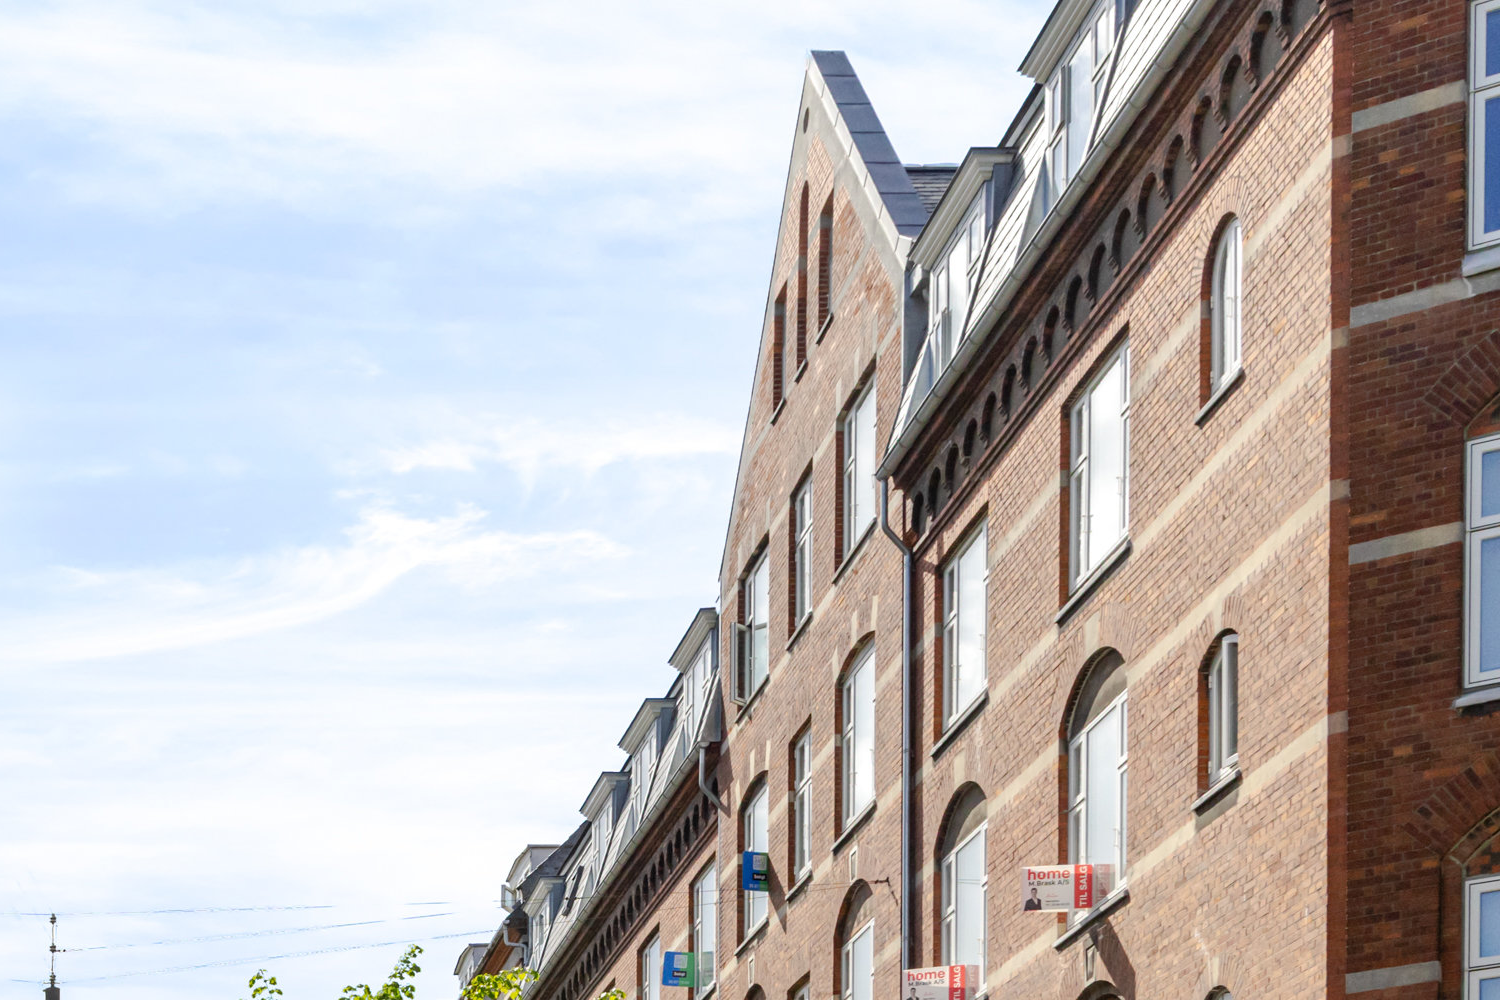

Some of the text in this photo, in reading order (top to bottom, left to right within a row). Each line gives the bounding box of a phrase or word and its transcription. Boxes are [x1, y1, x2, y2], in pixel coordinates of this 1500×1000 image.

[1028, 869, 1070, 880] home
[1079, 866, 1088, 906] TIL SALG
[908, 970, 945, 981] home
[953, 966, 961, 988] SALG
